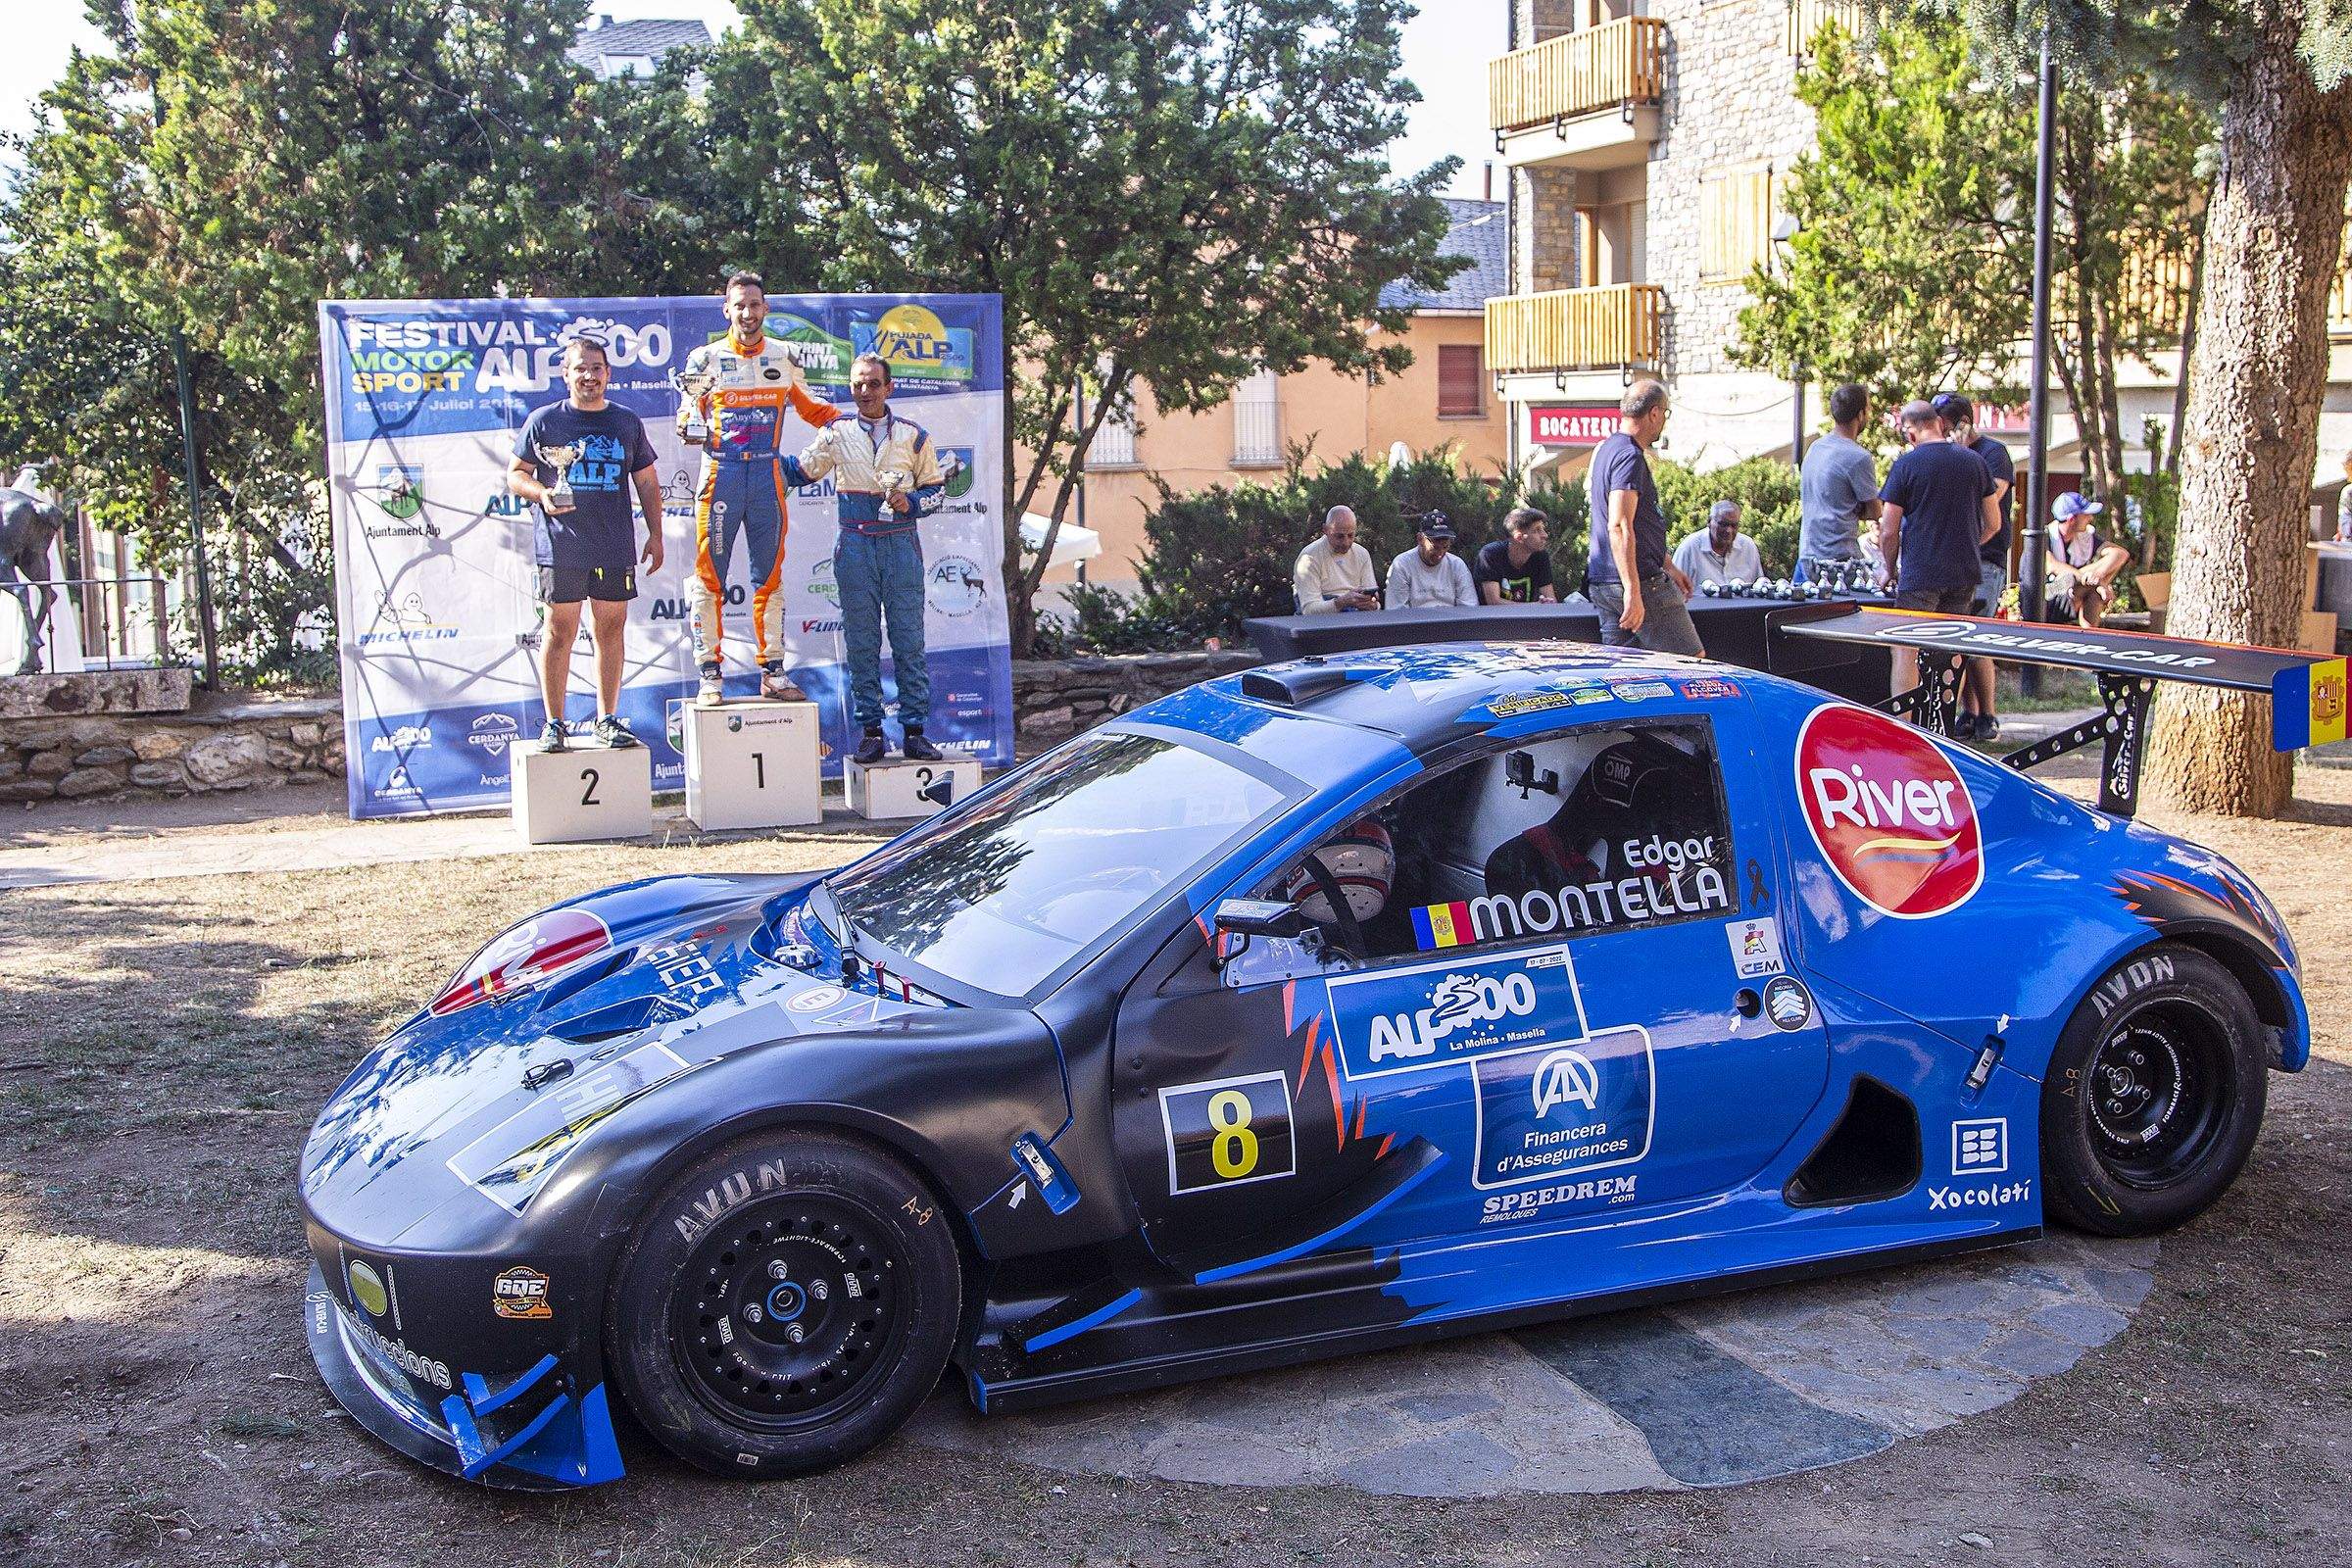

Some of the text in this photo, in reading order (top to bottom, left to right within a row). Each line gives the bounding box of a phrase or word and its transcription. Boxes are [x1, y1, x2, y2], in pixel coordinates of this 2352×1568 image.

[349, 320, 547, 350] FESTIVAL
[351, 350, 474, 371] MOTOR
[886, 338, 953, 360] ALP
[351, 371, 466, 393] SPORT
[1540, 416, 1625, 437] BOCATERI
[567, 462, 621, 484] ALP
[931, 502, 988, 514] ntament Alp
[367, 523, 441, 539] Ajuntament Alp
[934, 565, 956, 583] AE
[808, 584, 840, 593] CERD
[359, 628, 459, 646] MICHELIN
[1961, 631, 2218, 669] SILVER-CAR
[1493, 695, 1565, 711] VERIFICADO
[467, 732, 520, 745] CERDANYA
[932, 739, 991, 752] CHELIN
[752, 753, 764, 788] 1
[1605, 760, 1631, 781] OMP
[580, 768, 600, 805] 2
[915, 766, 933, 802] 3
[1809, 762, 1955, 829] River
[1624, 834, 1715, 872] Edgar
[1470, 862, 1729, 940] MONTELLÀ
[1741, 959, 1781, 975] CEM
[2090, 955, 2176, 1018] AVON
[1449, 1028, 1545, 1052] La Molina Masella
[1207, 1090, 1259, 1179] 8
[1524, 1121, 1607, 1149] Financera
[1496, 1138, 1628, 1173] d'Assegurances
[674, 1157, 787, 1243] AVON
[1483, 1175, 1638, 1214] SPEEDREM
[1608, 1193, 1635, 1204] .com
[1928, 1178, 2032, 1210] Xocolatí
[1480, 1207, 1539, 1224] REMOLQUES
[719, 1316, 732, 1345] BRAID
